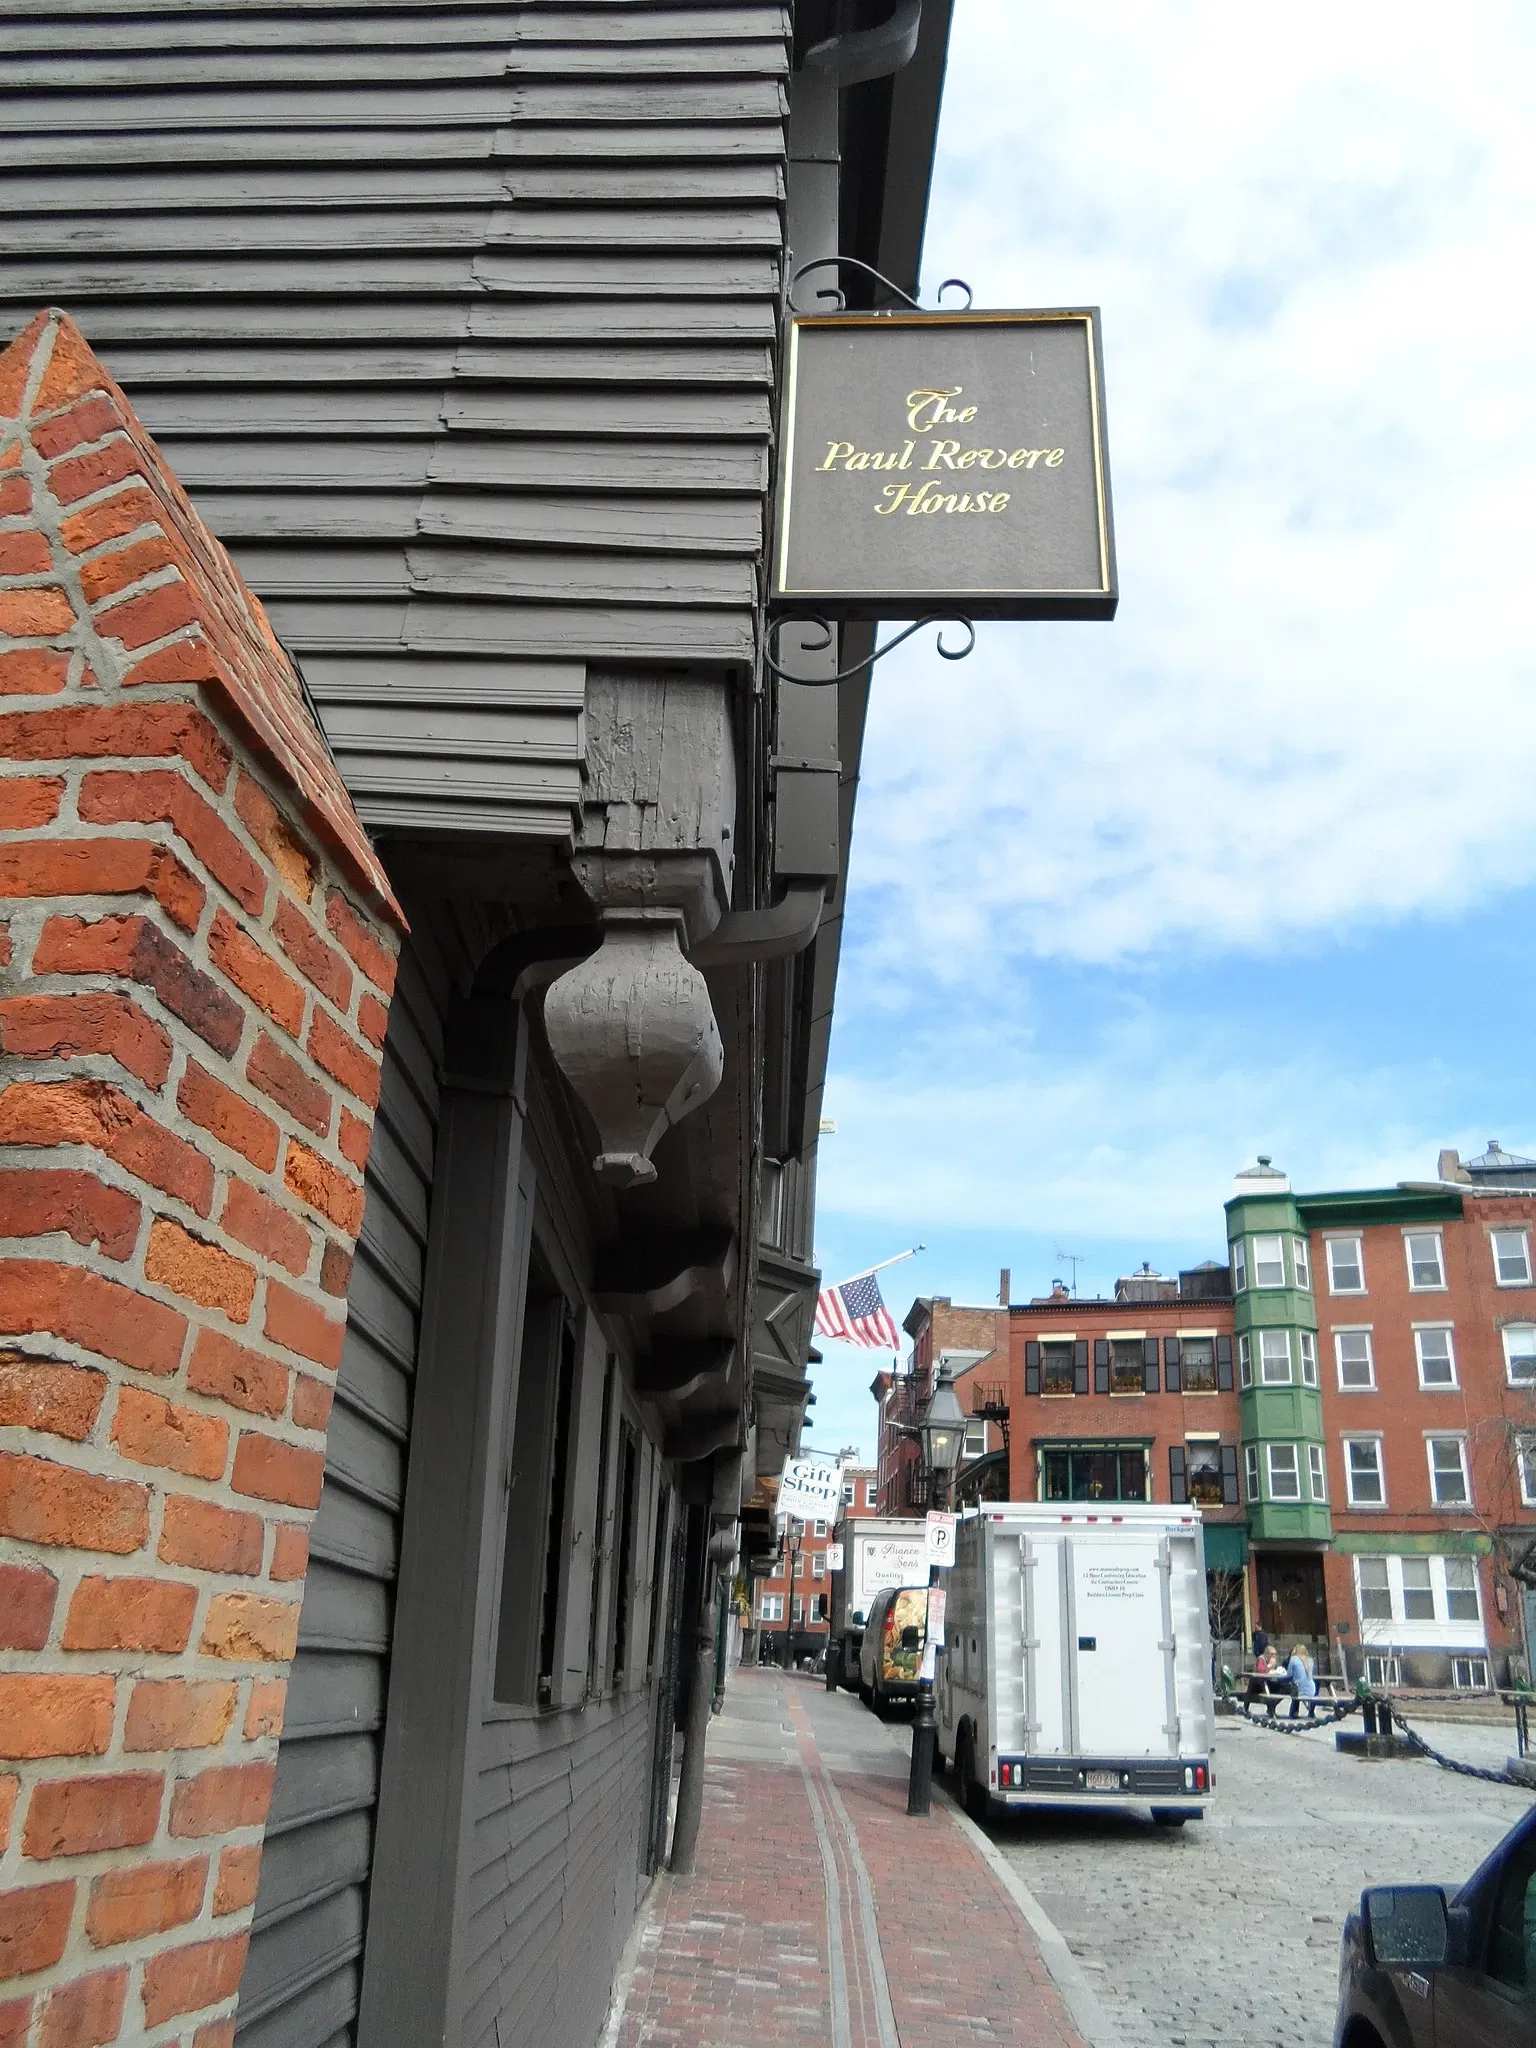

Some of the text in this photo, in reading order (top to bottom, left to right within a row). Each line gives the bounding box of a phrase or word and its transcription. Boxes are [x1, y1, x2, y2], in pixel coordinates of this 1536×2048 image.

[906, 386, 978, 433] The
[815, 440, 1065, 471] Paul Revere
[874, 480, 1011, 516] House
[793, 1465, 832, 1483] Gift
[783, 1476, 837, 1500] Shop
[892, 1555, 919, 1568] Sons
[876, 1571, 901, 1579] Quality
